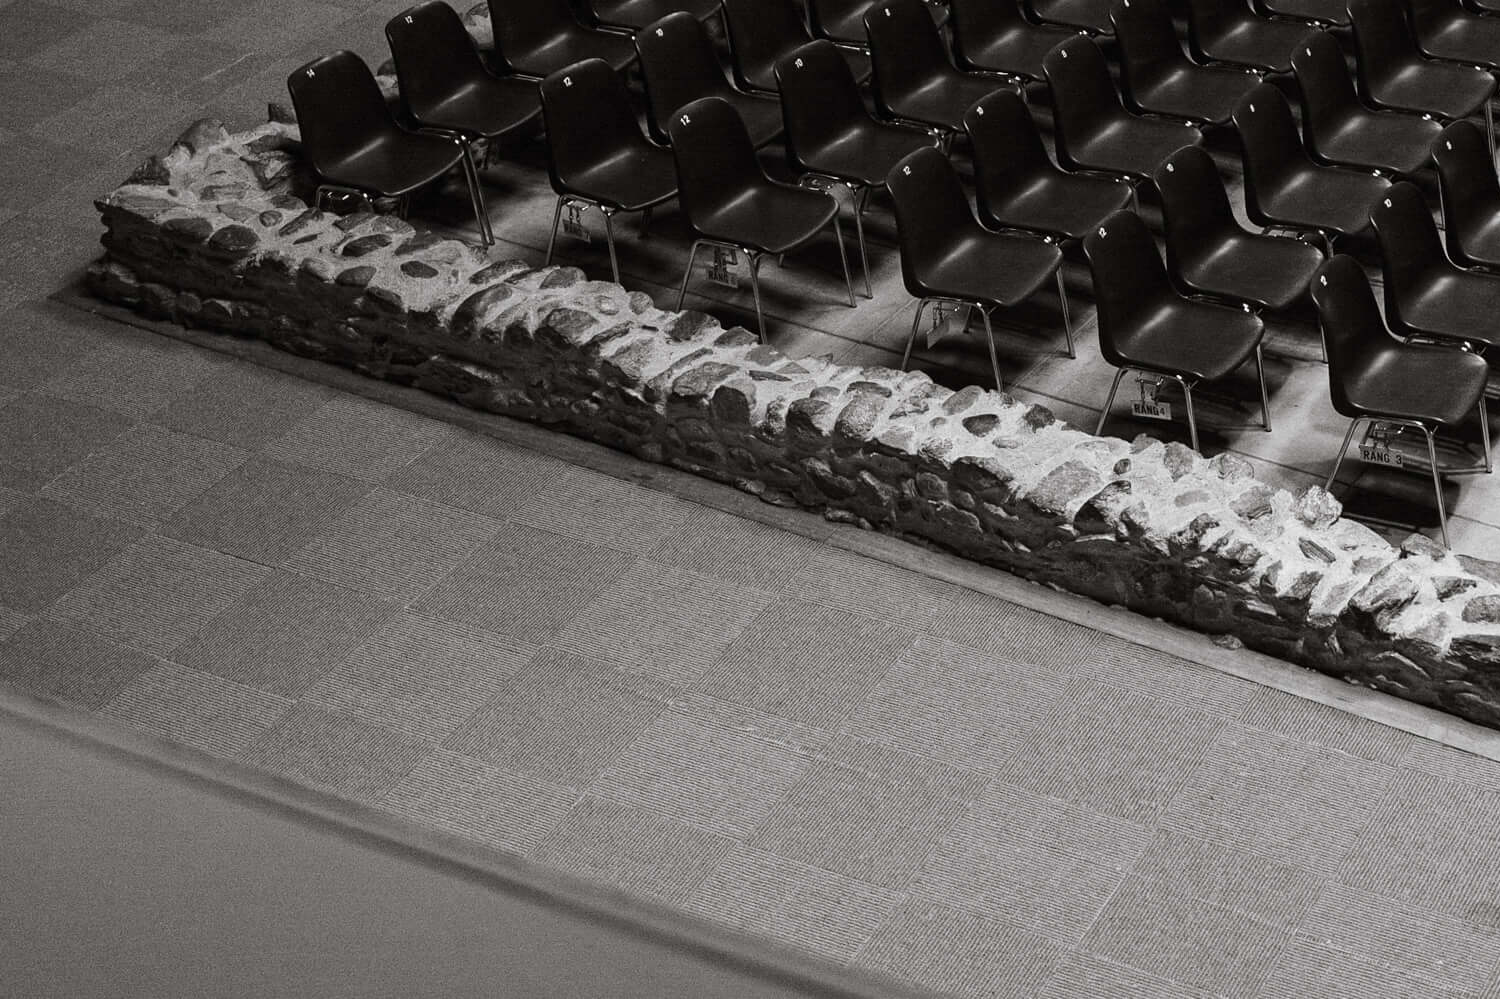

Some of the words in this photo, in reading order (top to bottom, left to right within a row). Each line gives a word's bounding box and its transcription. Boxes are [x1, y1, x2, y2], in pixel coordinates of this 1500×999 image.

[794, 58, 804, 69] 10
[680, 114, 691, 126] 12
[1134, 403, 1160, 417] RANG
[1363, 450, 1390, 464] RANG
[1395, 455, 1402, 465] 3
